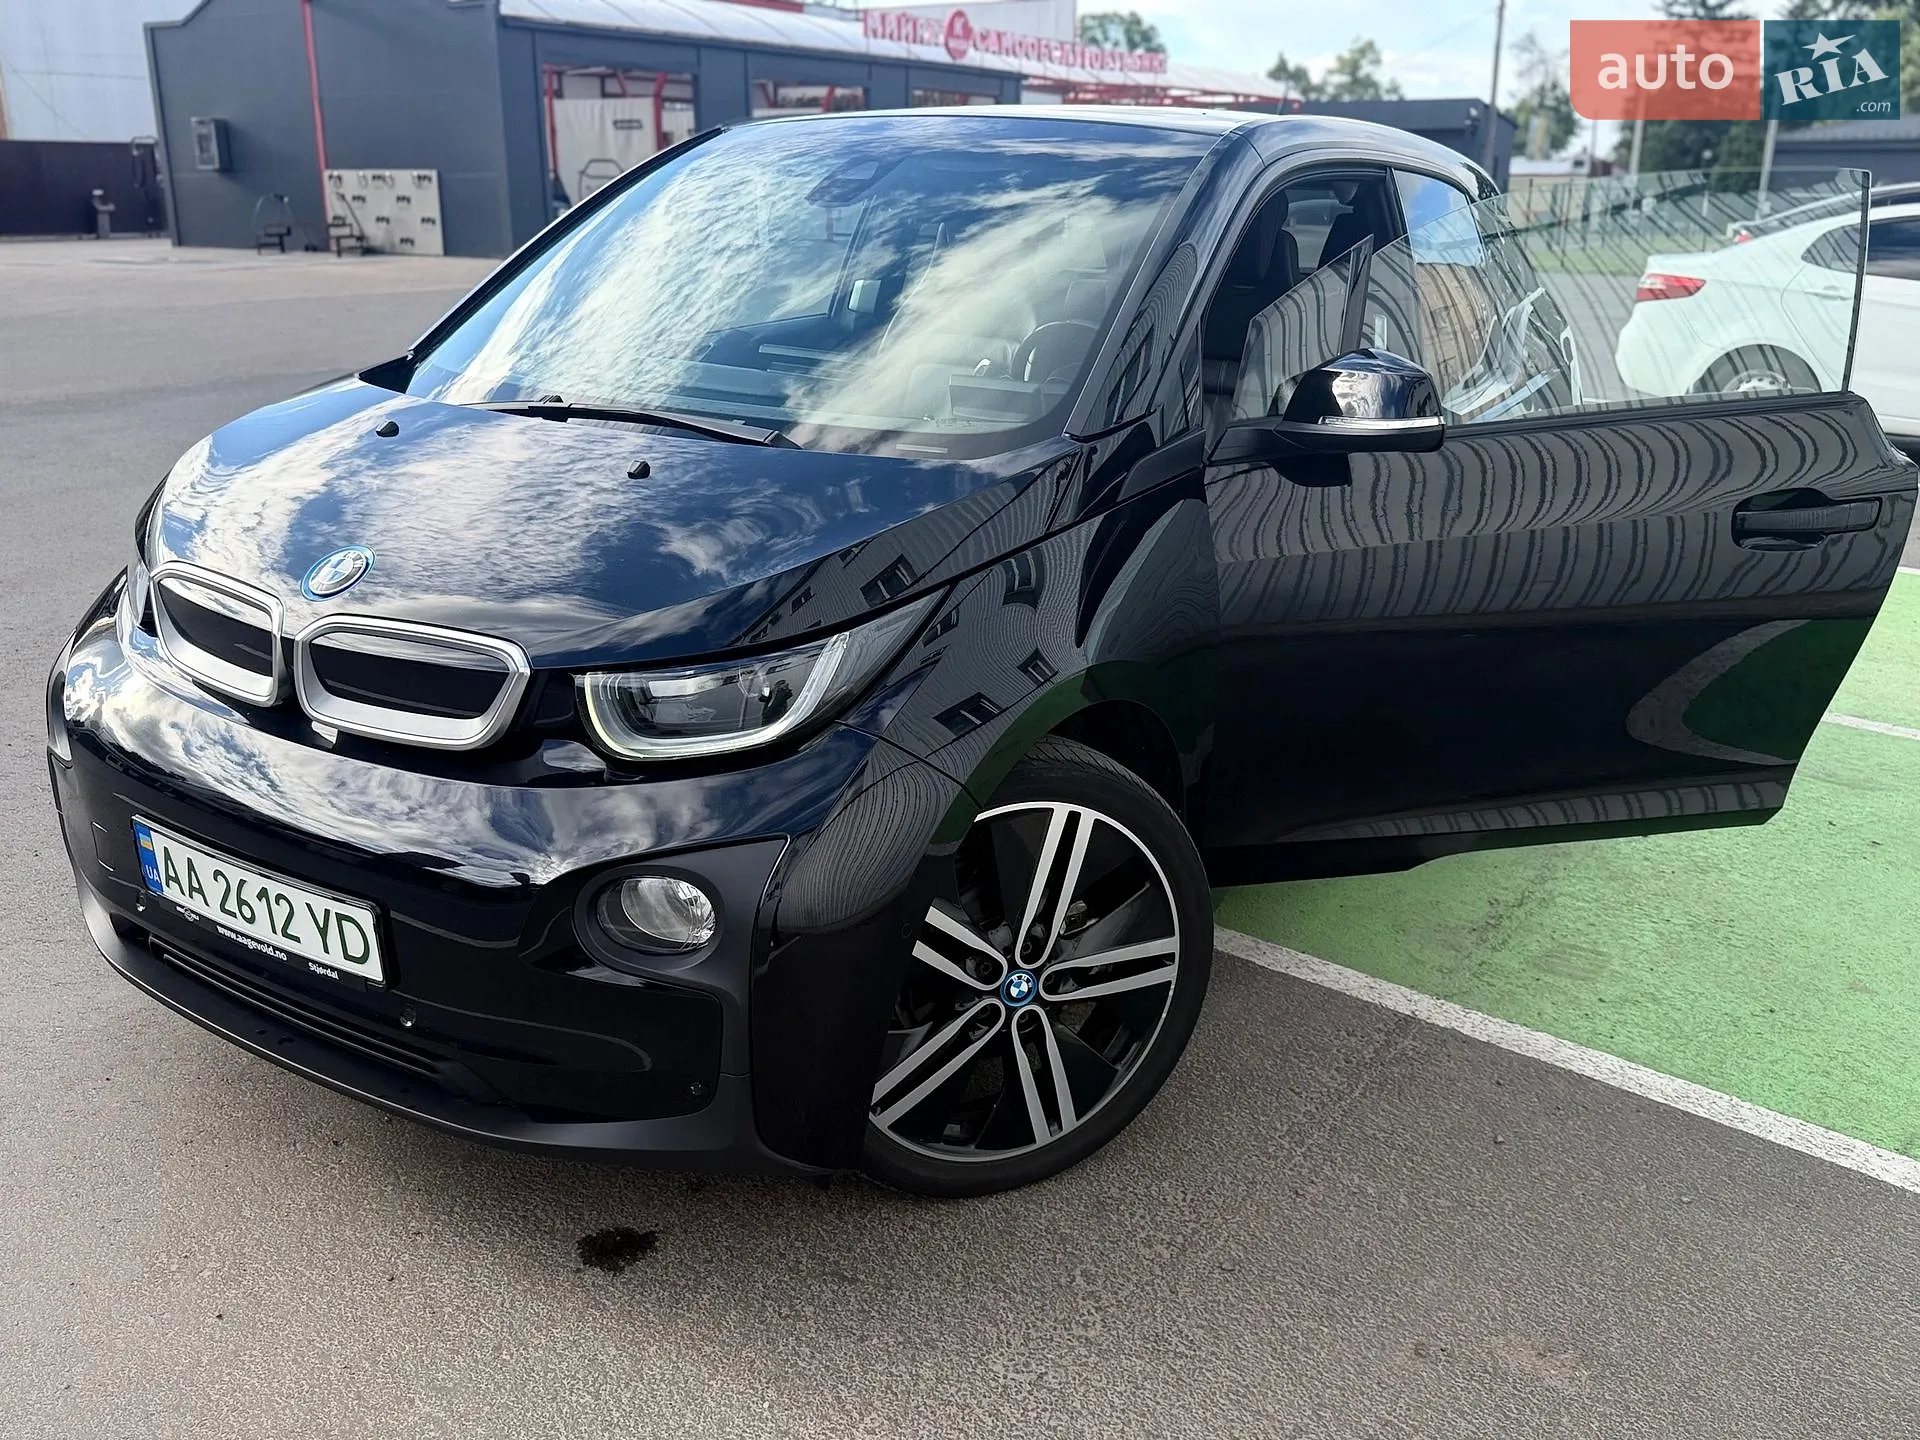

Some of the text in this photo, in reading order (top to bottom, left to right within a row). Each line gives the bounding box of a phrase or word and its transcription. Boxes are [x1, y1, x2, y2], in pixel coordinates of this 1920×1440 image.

[146, 864, 162, 884] UA
[163, 846, 370, 965] AA 2612 YD
[216, 925, 288, 961] www.aagevold.no
